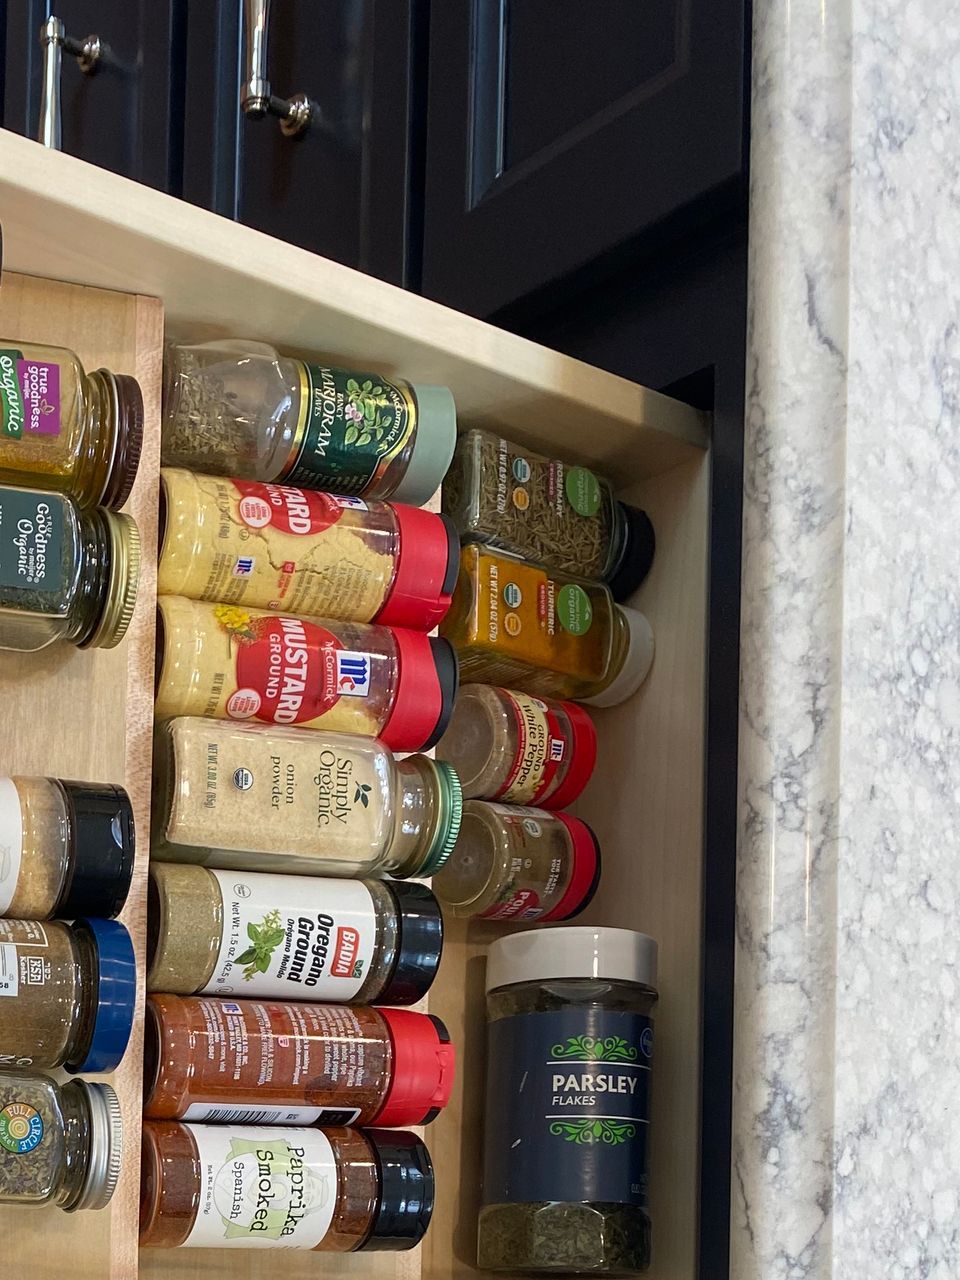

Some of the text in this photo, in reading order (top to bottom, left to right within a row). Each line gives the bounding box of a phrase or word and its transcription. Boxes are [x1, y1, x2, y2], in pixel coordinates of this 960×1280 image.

[39, 367, 48, 393] true
[315, 366, 336, 457] MARJORAM
[385, 391, 402, 442] McCormick
[499, 454, 506, 465] WT
[12, 519, 33, 575] Organic
[34, 503, 48, 578] Goodness
[491, 580, 497, 592] WT
[266, 633, 281, 698] GROUND
[273, 618, 307, 724] MUSTARD
[517, 704, 537, 786] White Pepper
[534, 725, 544, 772] GROUND
[271, 756, 283, 810] powder
[286, 764, 296, 804] onion
[335, 758, 353, 824] Simply
[230, 902, 240, 944] Net 1.5
[276, 918, 295, 979] Orégano Molido
[287, 918, 315, 983] Ground
[304, 914, 334, 986] Oregano
[337, 931, 356, 973] BADIA
[552, 1074, 637, 1094] PARSLEY
[552, 1096, 596, 1105] FLAKES
[20, 1117, 41, 1151] CIRCLE
[230, 1162, 244, 1220] Spanish
[250, 1149, 275, 1232] Smoked
[281, 1146, 305, 1237] Paprika
